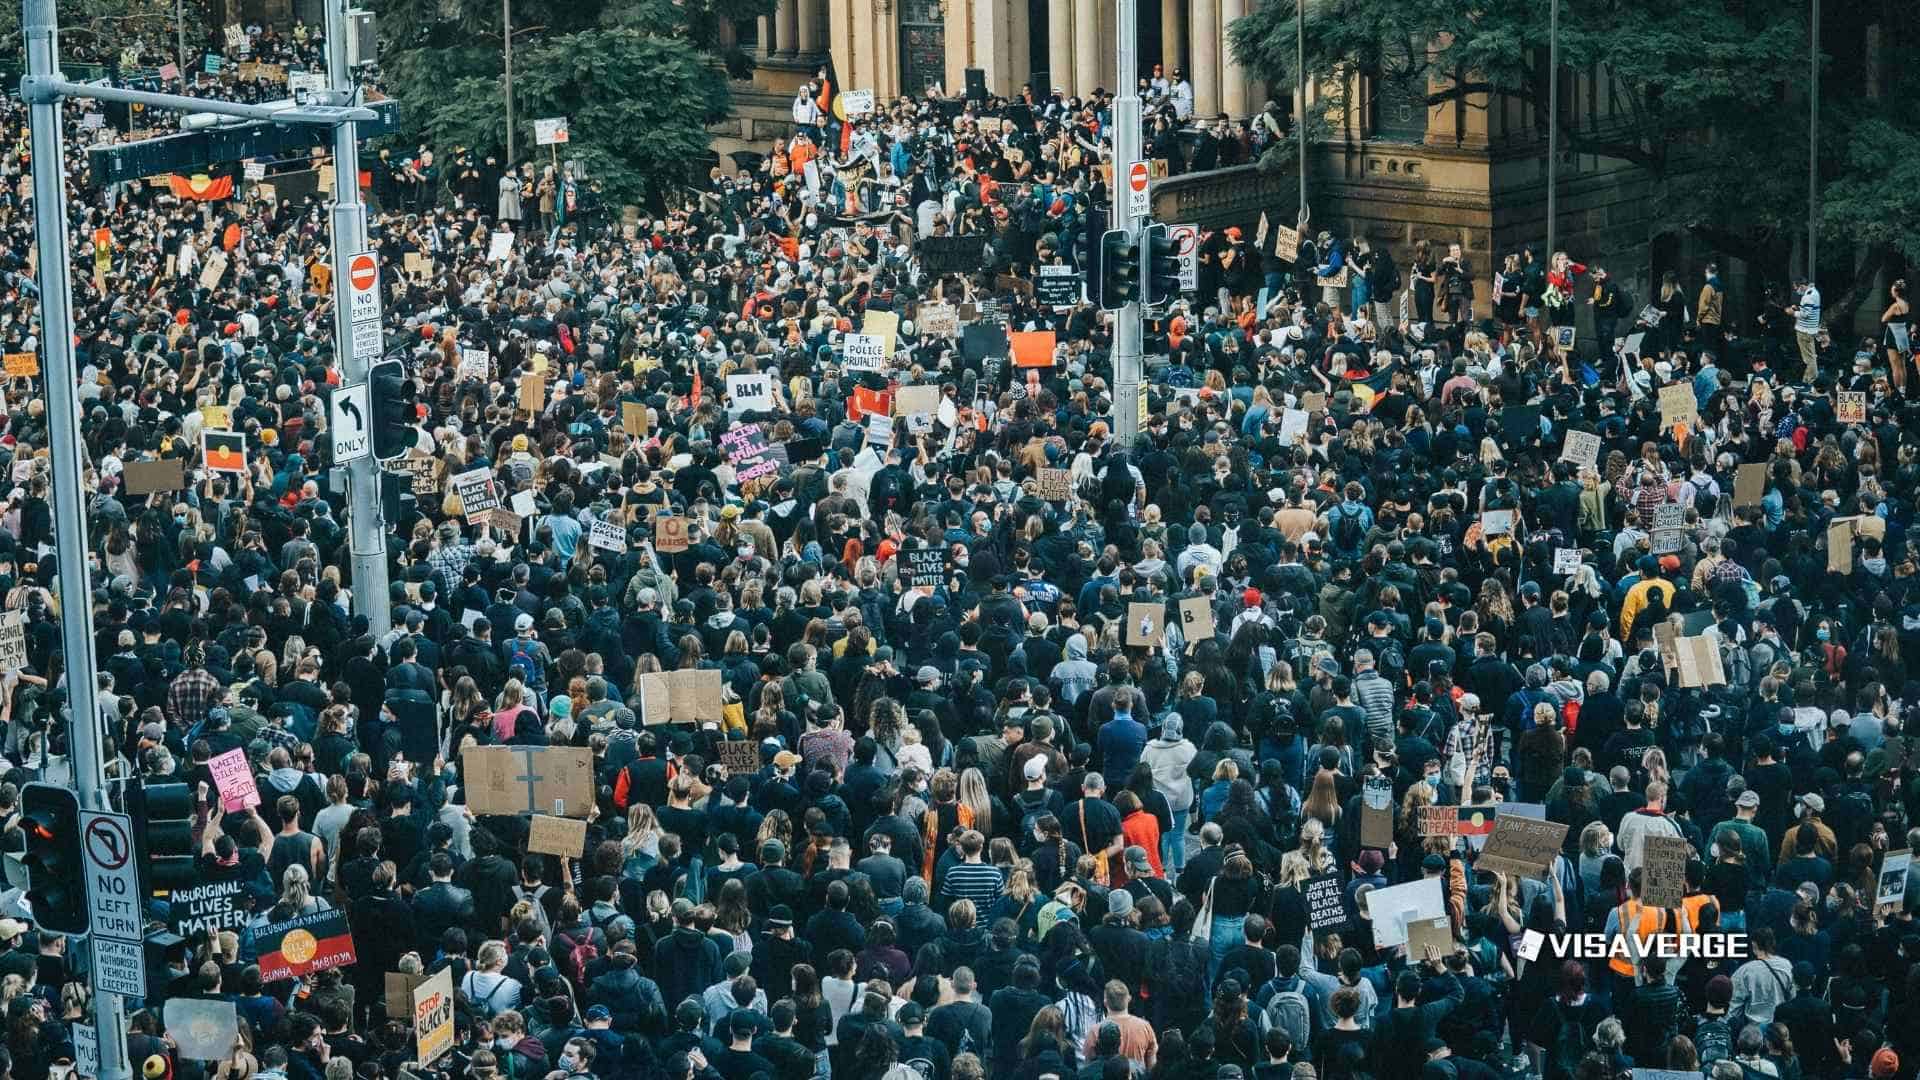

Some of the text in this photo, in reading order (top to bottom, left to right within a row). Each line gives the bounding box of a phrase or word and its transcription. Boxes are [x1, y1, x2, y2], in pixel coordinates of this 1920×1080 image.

[1134, 194, 1145, 203] NO
[357, 293, 372, 305] NO
[352, 306, 377, 318] ENTRY
[859, 335, 871, 344] FK
[849, 345, 883, 355] POLICE
[736, 382, 763, 398] BLM
[720, 423, 761, 445] RACISM
[336, 437, 365, 455] ONLY
[737, 437, 750, 450] IS
[729, 442, 769, 464] SMALL
[461, 482, 487, 495] BLACK
[464, 493, 486, 505] LIVES
[466, 499, 497, 513] MATTER
[909, 551, 943, 562] BLACK
[917, 562, 944, 574] LIVES
[911, 574, 944, 586] MATTER
[1183, 610, 1194, 623] B
[15, 640, 25, 653] IN
[720, 743, 757, 756] BLACK
[211, 753, 241, 770] WHITE
[214, 762, 248, 780] SILENCE
[1428, 807, 1457, 820] JUSTICE
[1429, 821, 1457, 834] PEACE
[97, 875, 126, 895] NO
[1309, 878, 1338, 892] JUSTICE
[1306, 886, 1342, 902] FOR ALL
[97, 897, 130, 915] LEFT
[190, 897, 233, 915] LIVES
[1311, 896, 1340, 911] BLACK
[1310, 905, 1344, 921] DEATHS
[96, 915, 135, 933] TURN
[178, 910, 247, 937] MATTER
[1310, 914, 1348, 929] IN CUSTODY
[97, 943, 119, 953] LIGHT
[100, 954, 138, 969] AUTHORISED
[102, 967, 138, 981] VEHICLES
[102, 978, 139, 993] EXCEPTED
[418, 991, 441, 1019] STOP
[419, 1004, 444, 1038] BLACK
